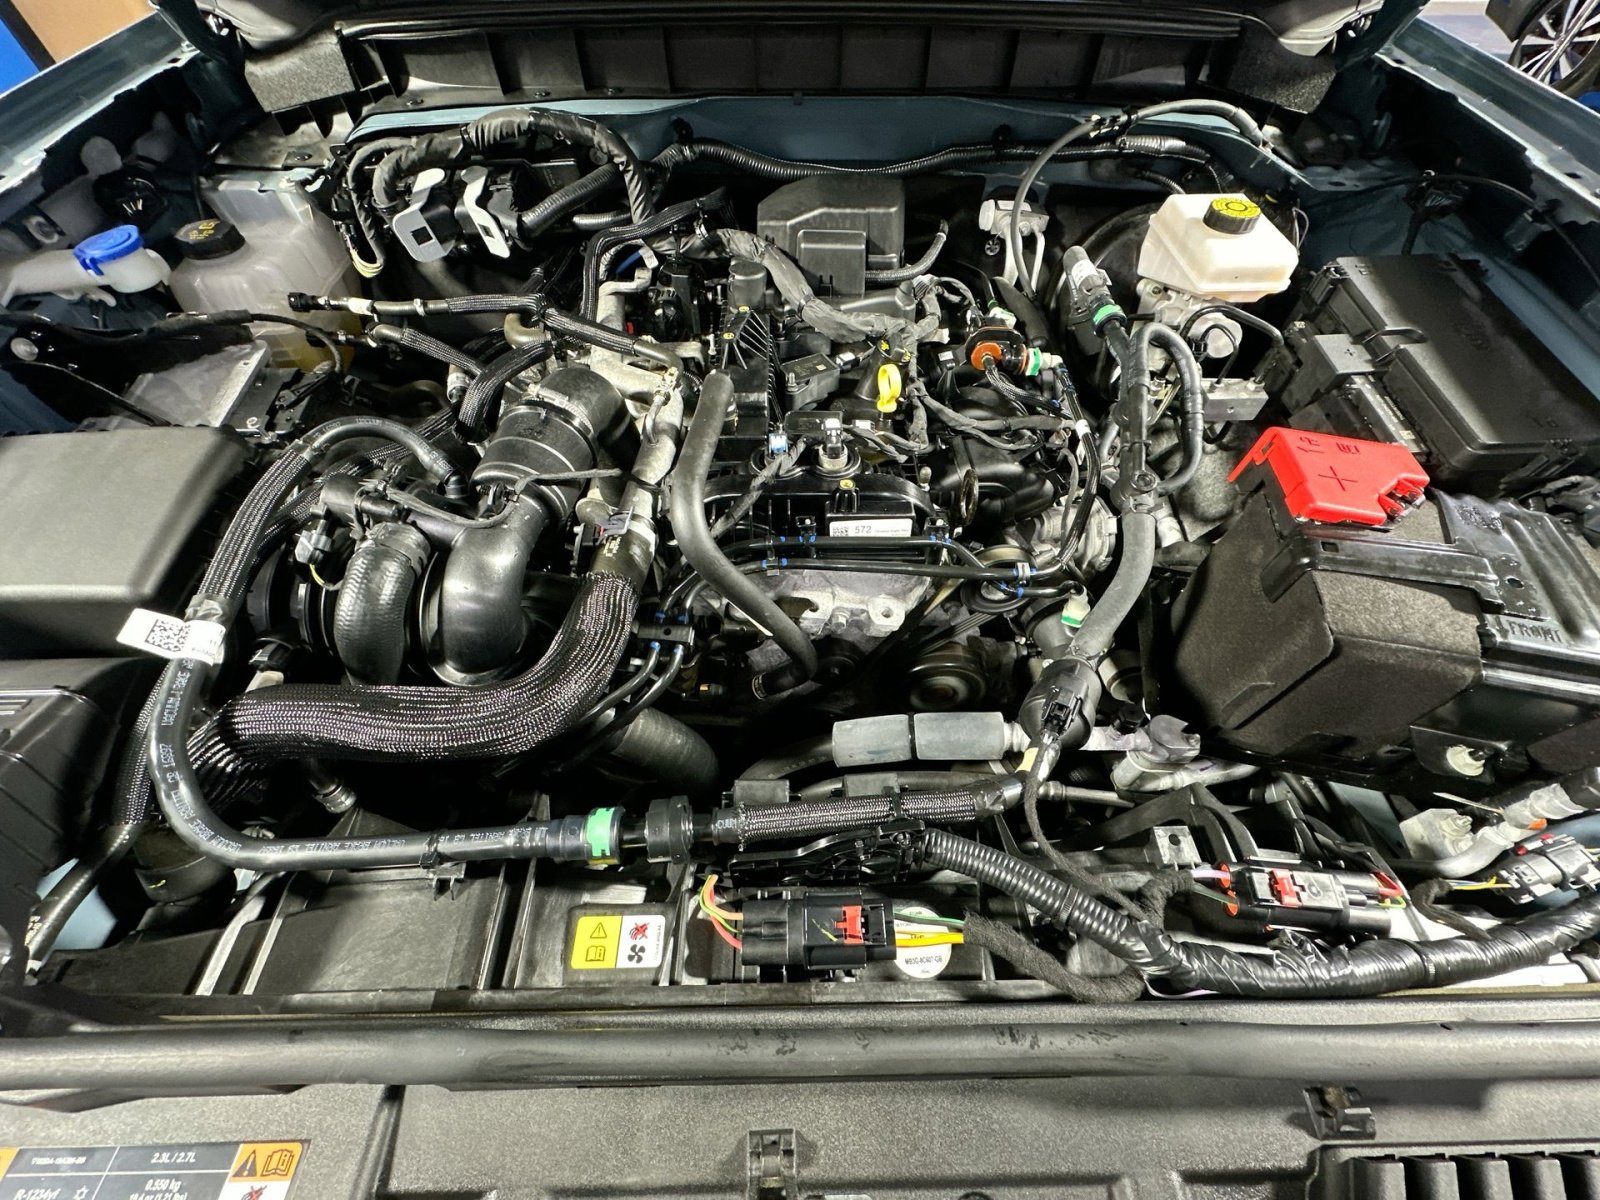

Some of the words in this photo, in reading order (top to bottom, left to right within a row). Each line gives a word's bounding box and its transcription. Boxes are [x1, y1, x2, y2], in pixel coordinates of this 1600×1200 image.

[854, 525, 872, 534] 572
[1507, 620, 1563, 643] FRONT
[176, 1151, 196, 1163] 2.7L
[144, 1178, 170, 1191] 0.550
[169, 1179, 182, 1192] kg
